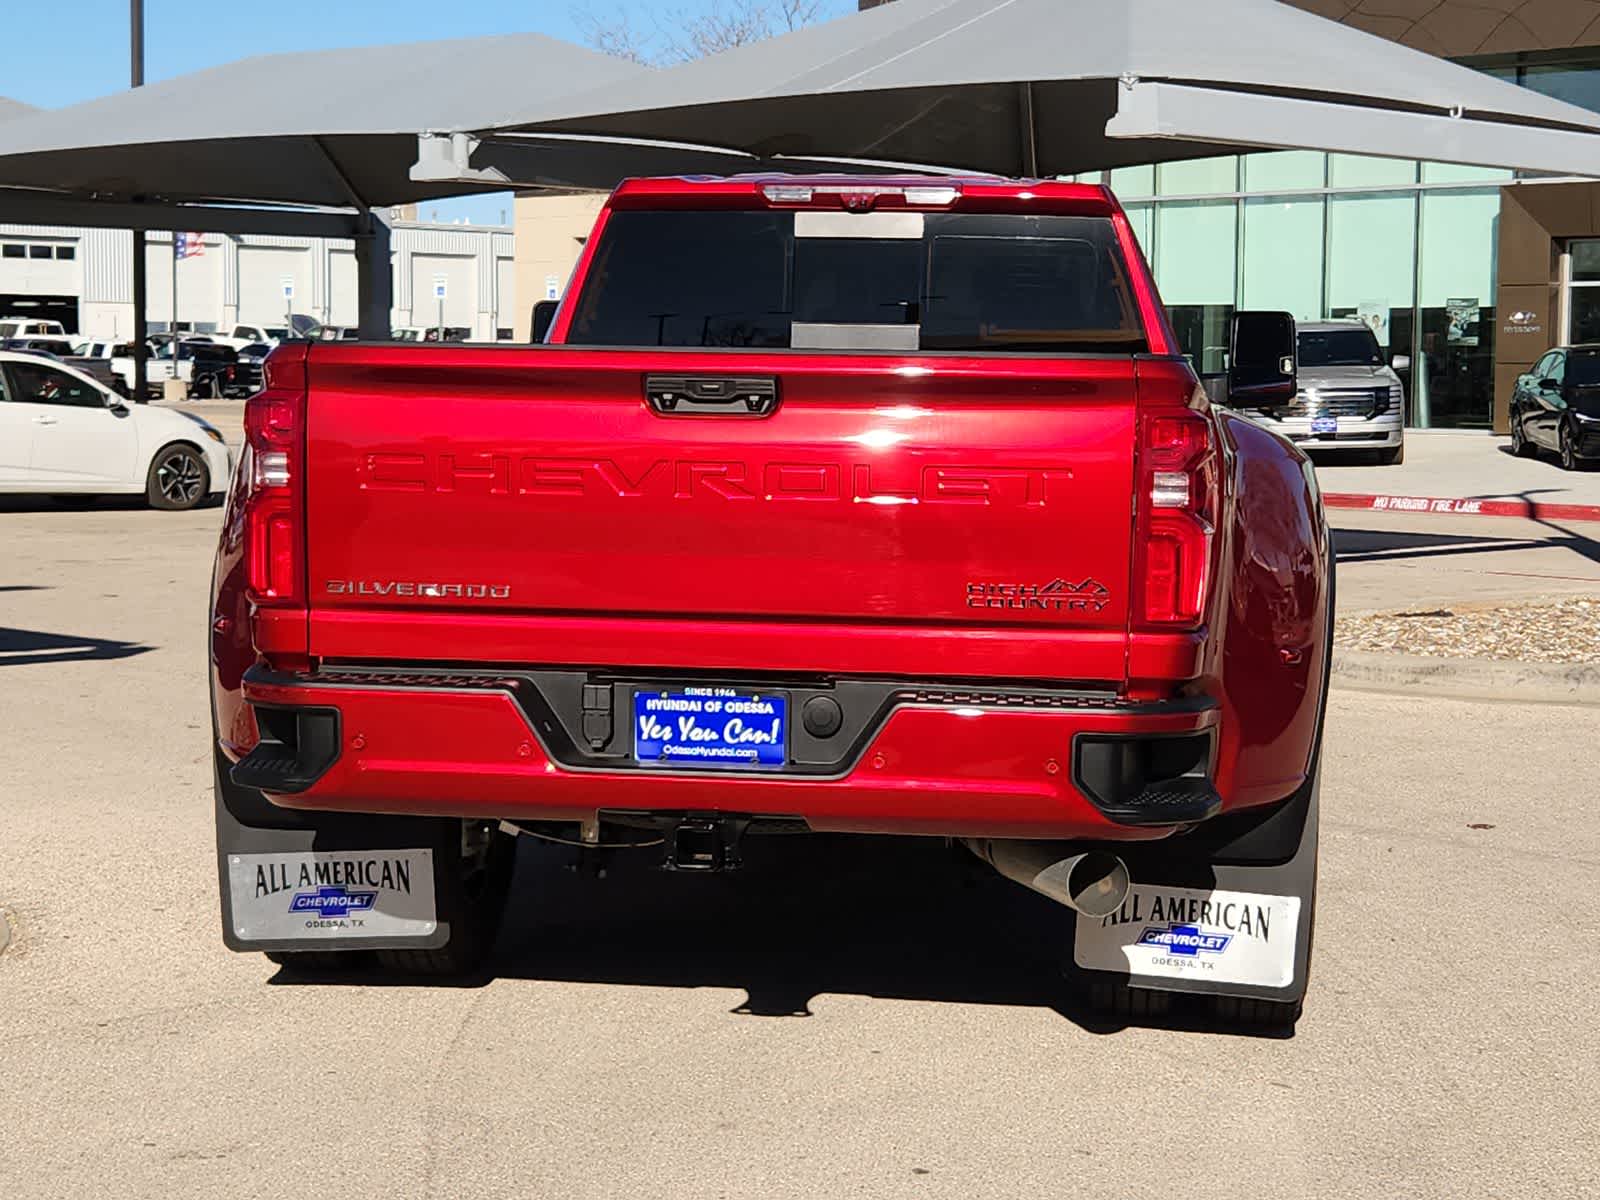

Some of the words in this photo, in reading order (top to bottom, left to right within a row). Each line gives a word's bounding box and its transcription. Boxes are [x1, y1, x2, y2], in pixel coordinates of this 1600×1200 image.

[357, 451, 1075, 506] CHEVROLET
[1374, 496, 1388, 508] NO
[1389, 497, 1429, 510] PARKING
[1430, 499, 1453, 512] FIRE
[1454, 500, 1482, 513] LANE
[326, 580, 511, 599] SILVERADO
[967, 582, 1038, 596] HIGH
[967, 594, 1110, 611] COUNTRY
[684, 687, 712, 697] SINCE
[646, 699, 702, 711] HYUNDAI
[704, 701, 722, 713] OF
[724, 701, 774, 714] ODESSA
[639, 715, 673, 741] Yes
[678, 716, 719, 742] You
[723, 717, 781, 744] Can!
[662, 744, 758, 758] OdessaHyundai.com
[255, 863, 292, 898] ALL
[298, 859, 411, 895] AMERICAN
[297, 895, 370, 908] CHEVROLET
[305, 919, 350, 929] ODESSA,
[351, 919, 365, 928] TX
[1150, 895, 1272, 943] AMERICAN
[1145, 932, 1225, 949] CHEVROLET
[1201, 960, 1215, 970] TX
